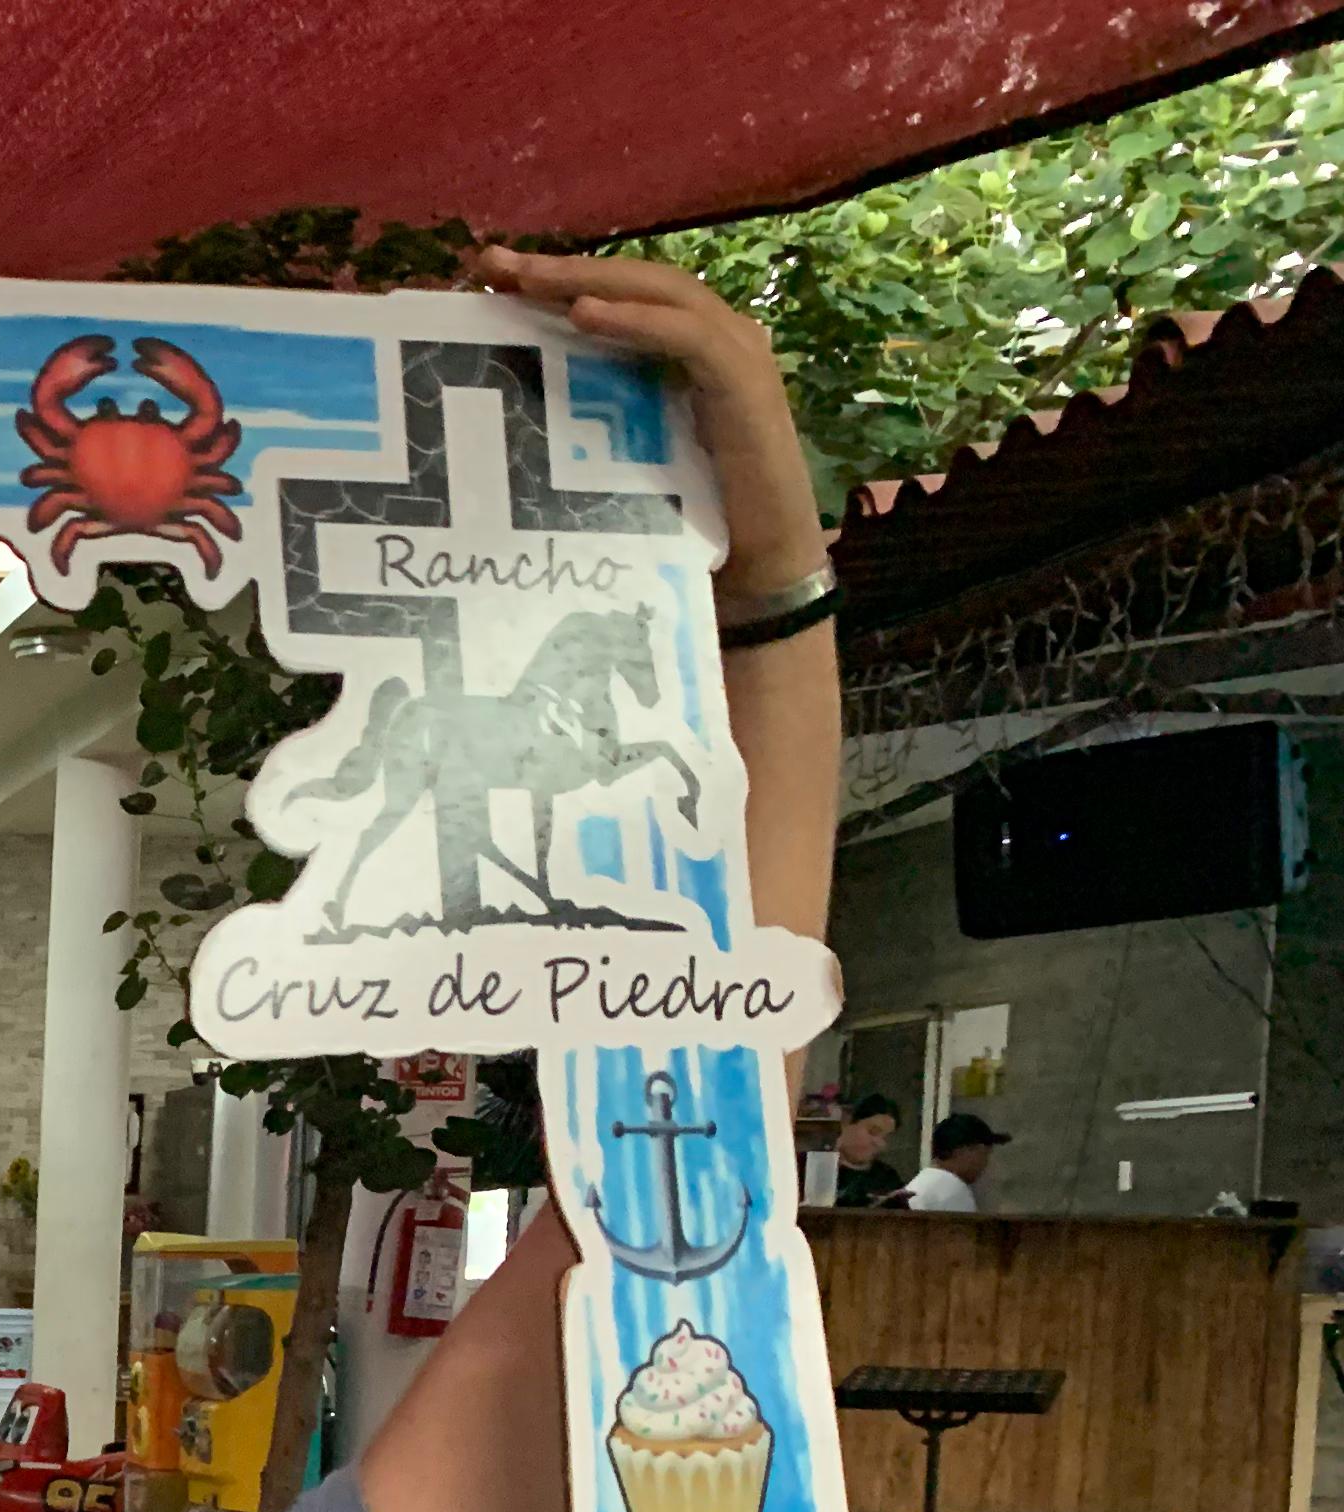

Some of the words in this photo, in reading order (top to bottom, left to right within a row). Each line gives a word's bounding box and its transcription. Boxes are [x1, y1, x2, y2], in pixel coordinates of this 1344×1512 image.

[376, 532, 633, 595] Rancho
[216, 956, 399, 1024] Cruz
[428, 953, 522, 1019] de
[543, 955, 794, 1023] Piedra
[399, 1085, 460, 1097] TINTOR
